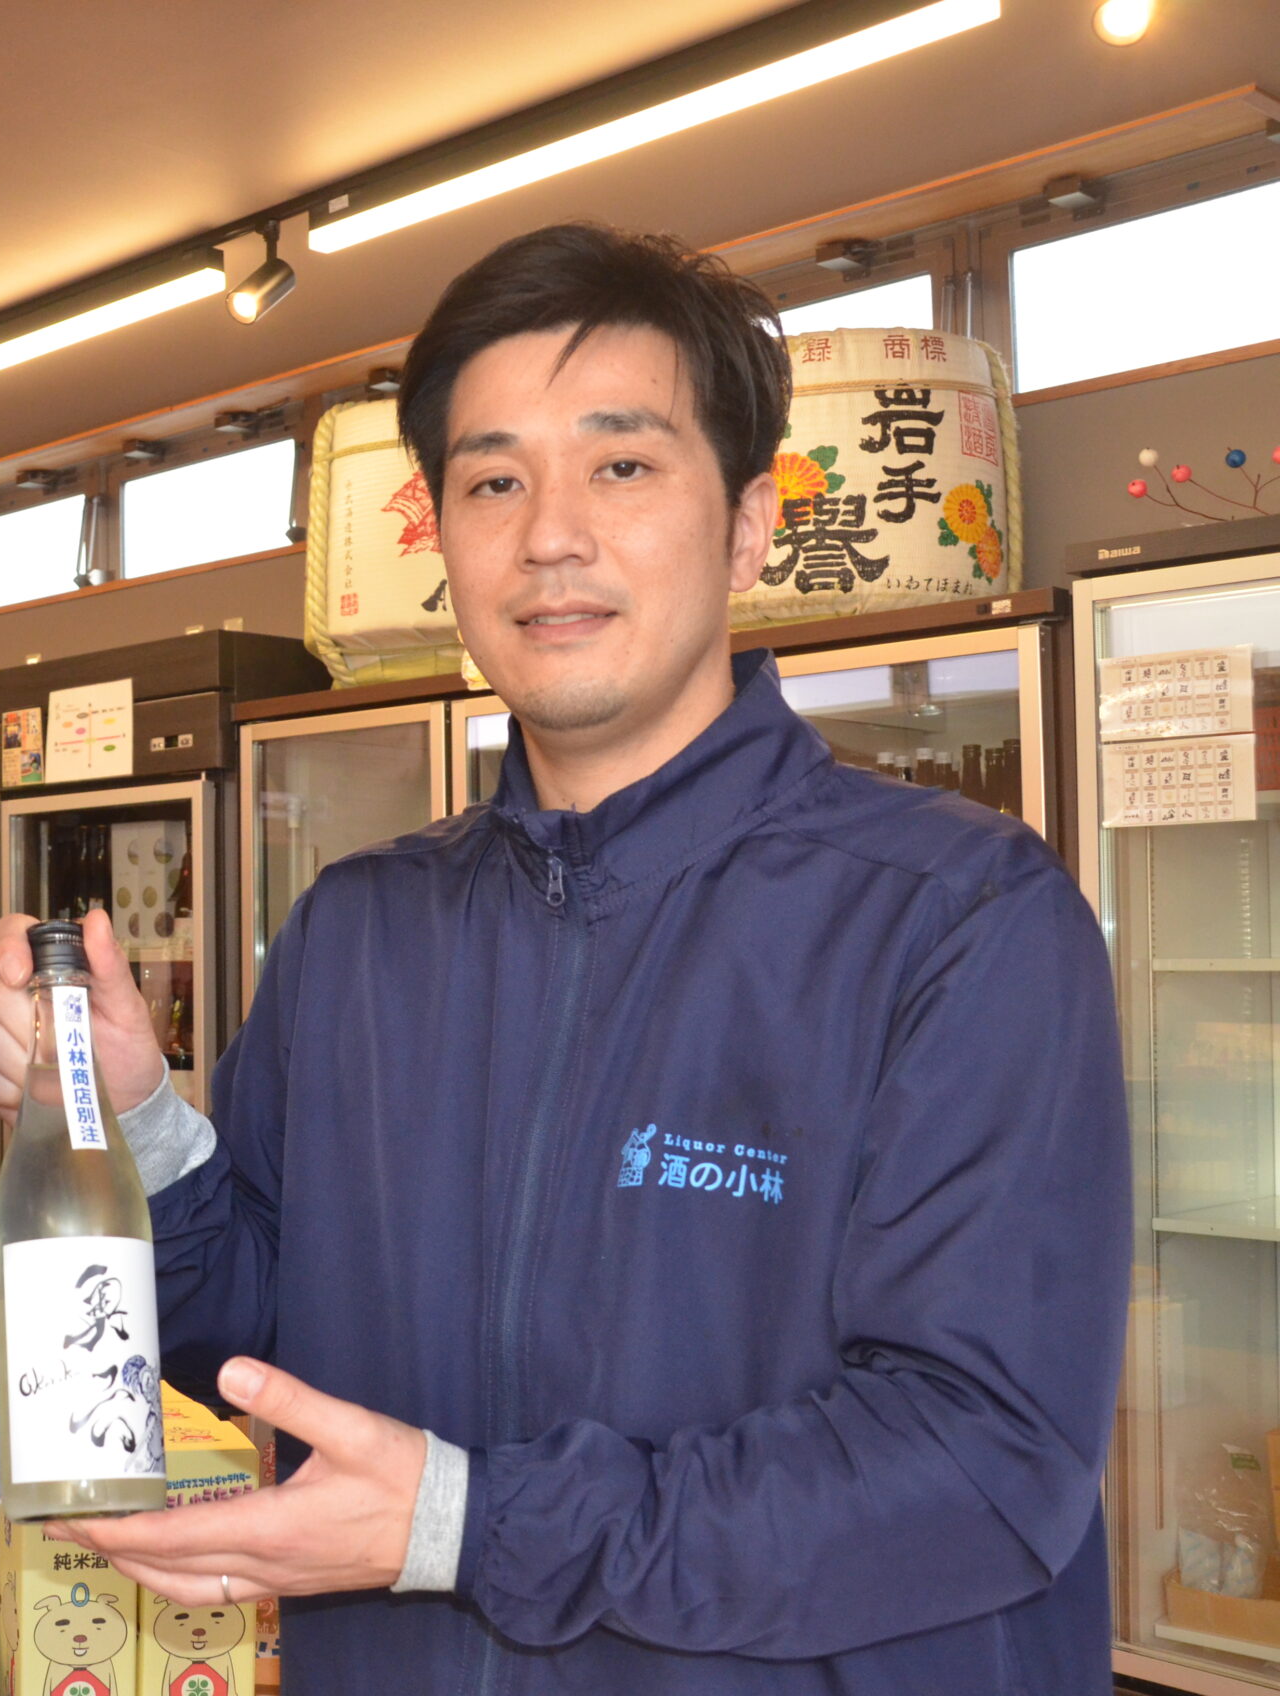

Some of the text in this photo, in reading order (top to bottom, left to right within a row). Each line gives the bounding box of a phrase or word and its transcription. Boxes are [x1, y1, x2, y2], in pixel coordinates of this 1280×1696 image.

[883, 334, 948, 363] 商標
[859, 379, 946, 523] 岩手
[886, 574, 974, 597] いわてほまれ
[66, 1028, 100, 1143] 小林商店別注
[664, 1133, 788, 1165] Liquor Center
[657, 1152, 785, 1205] 酒の小林
[53, 1552, 109, 1571] 純米酒
